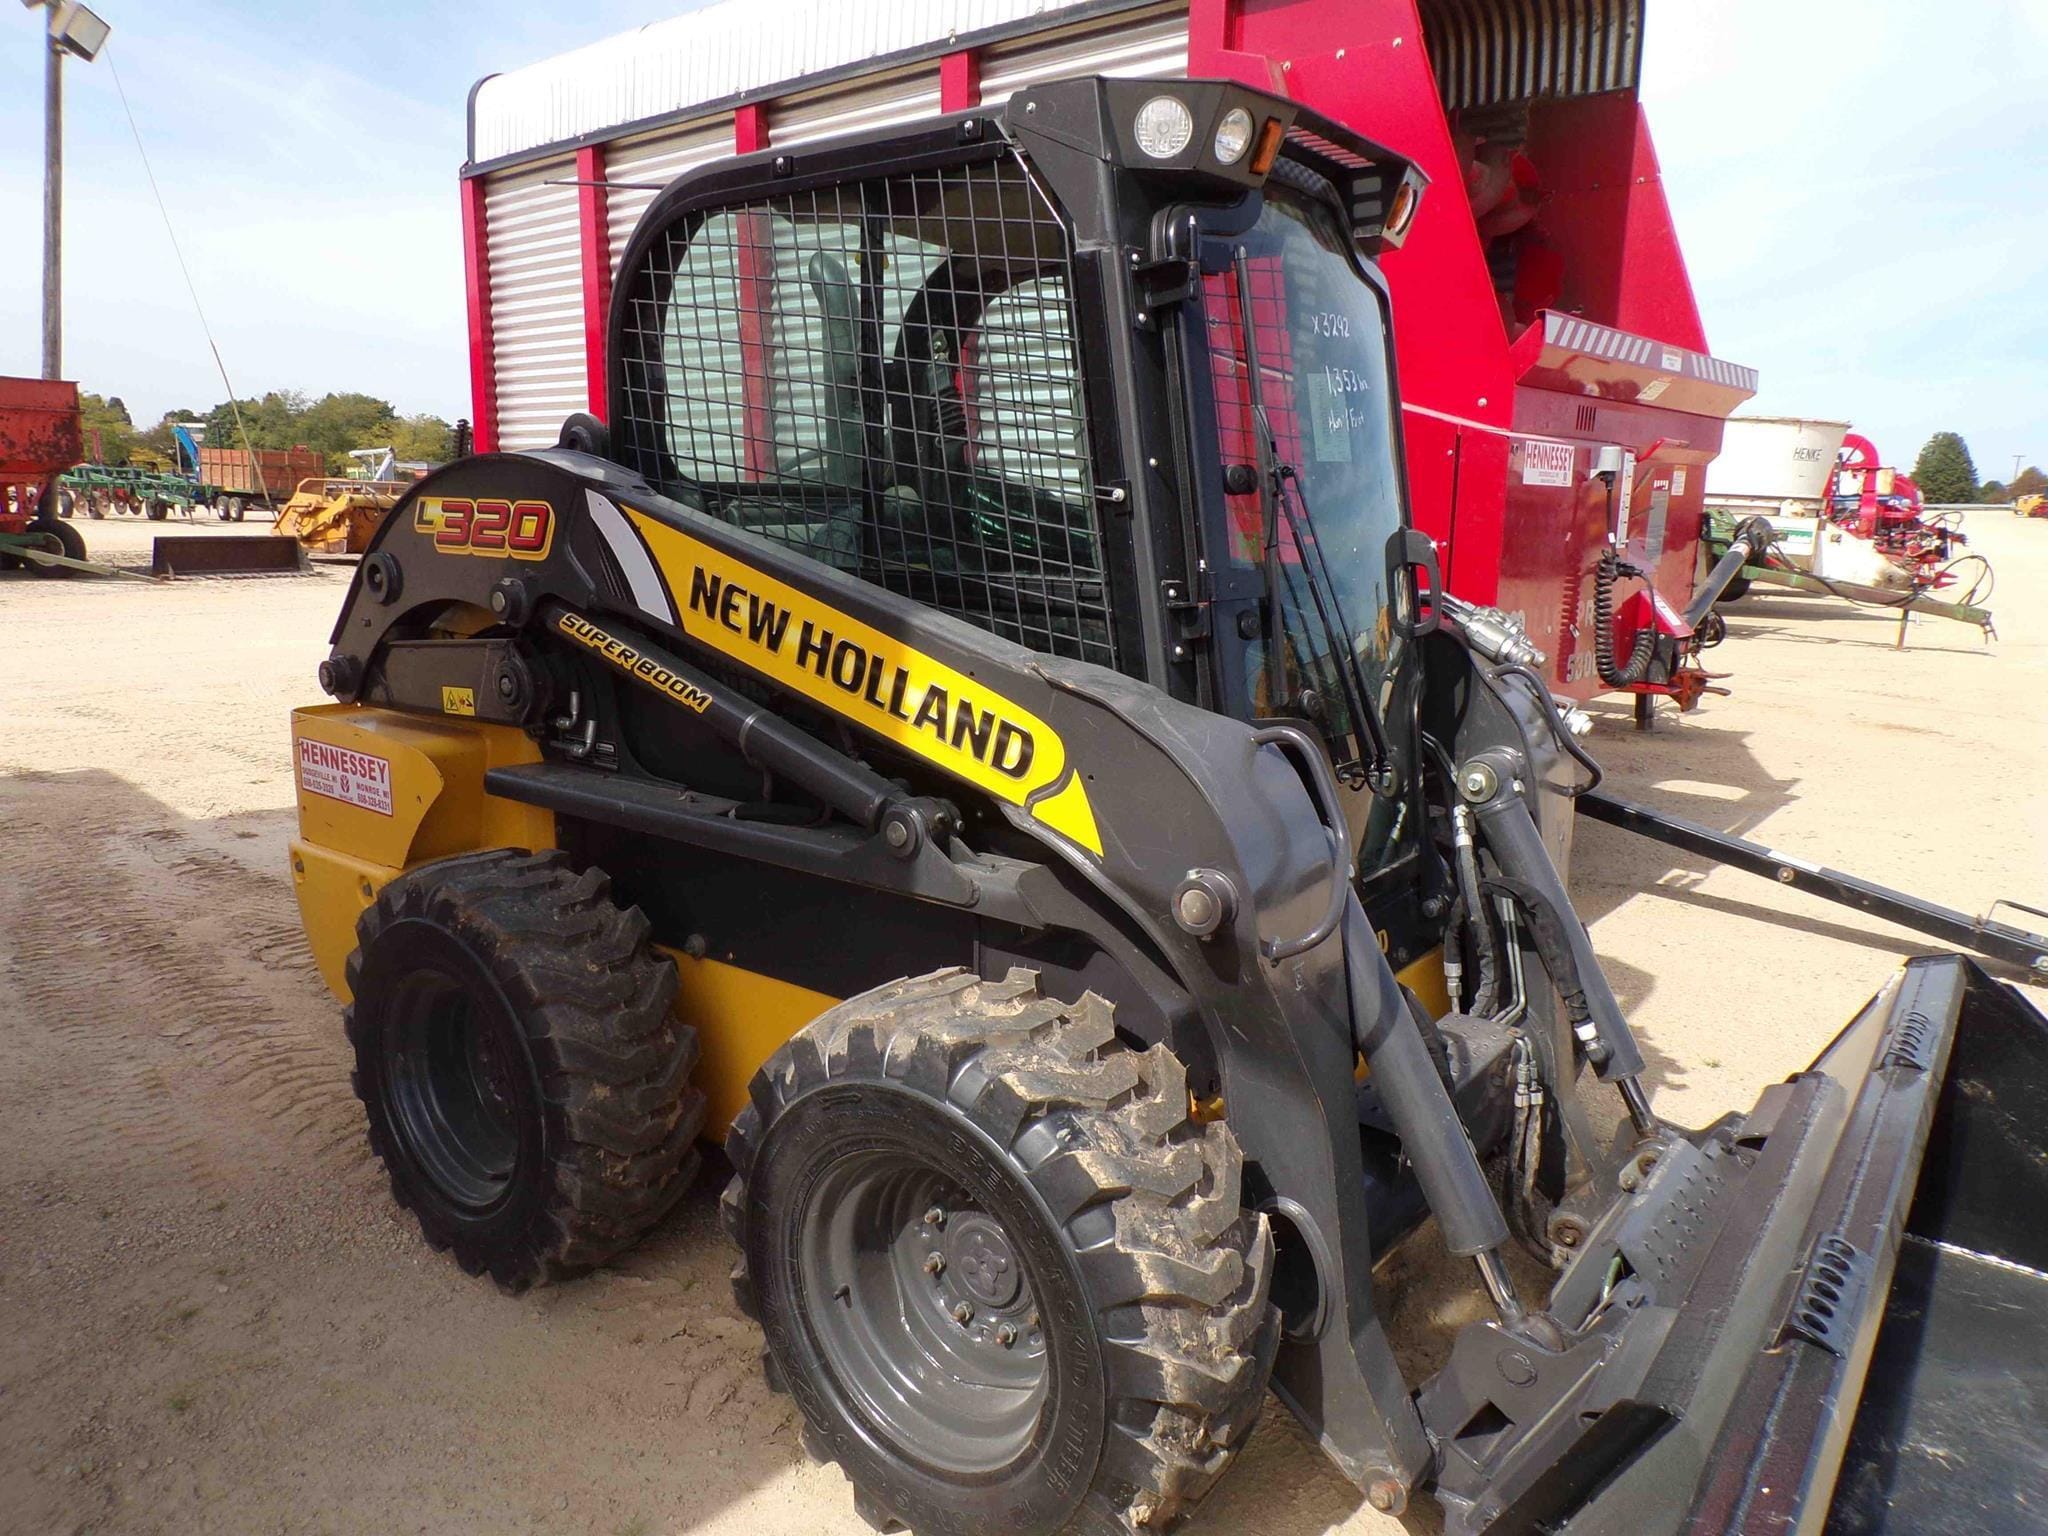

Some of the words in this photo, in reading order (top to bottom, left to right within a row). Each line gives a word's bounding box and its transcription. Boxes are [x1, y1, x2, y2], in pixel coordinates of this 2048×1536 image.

[1525, 443, 1574, 471] HENNESSEY
[1793, 447, 1823, 460] HENKE
[415, 498, 555, 560] L320
[559, 613, 639, 670] SUPER
[634, 657, 712, 714] BOOM
[688, 565, 791, 654] NEW
[796, 619, 1036, 782] HOLLAND
[301, 741, 386, 783] HENNESSEY
